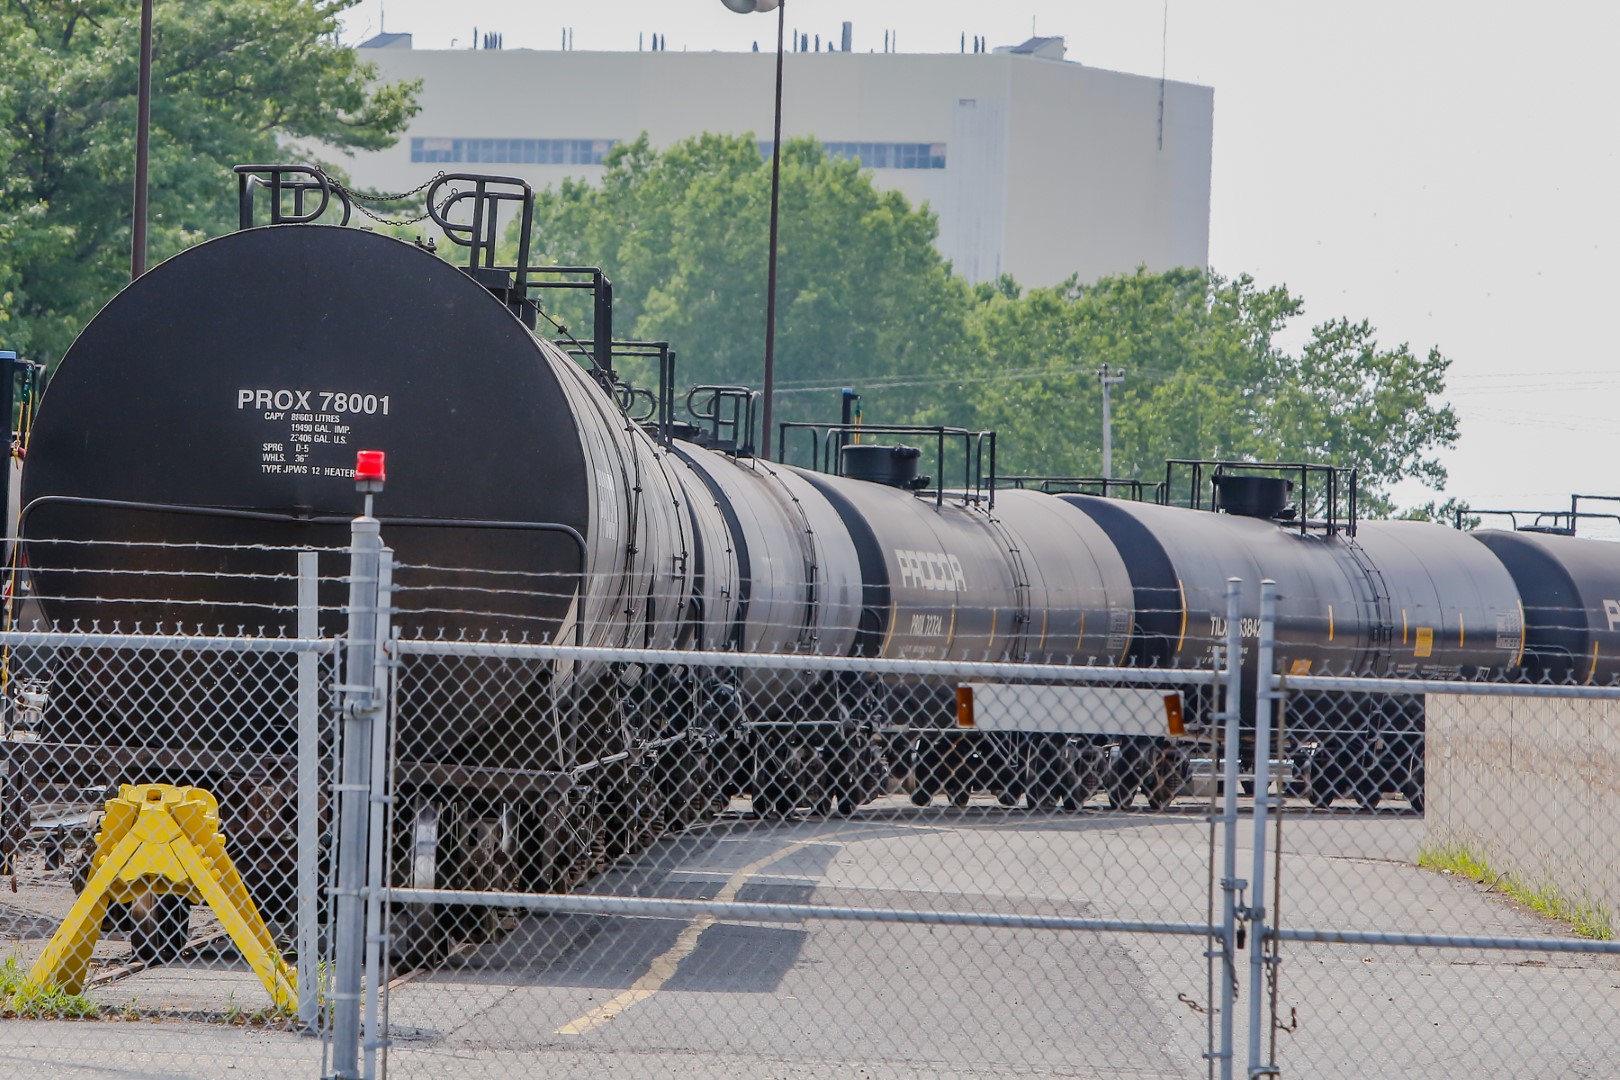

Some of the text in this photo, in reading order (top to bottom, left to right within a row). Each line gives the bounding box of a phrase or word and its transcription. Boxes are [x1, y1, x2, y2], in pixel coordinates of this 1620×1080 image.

[237, 389, 390, 415] PROX 78001
[264, 411, 285, 421] CAPY
[315, 413, 340, 423] LITRES
[291, 423, 351, 434] 19490 GAL. IMP.
[313, 434, 331, 444] GAL.
[333, 435, 348, 445] U.S.
[262, 442, 310, 453] SPRG D-5
[262, 453, 309, 463] WHLS. 36"
[261, 464, 282, 474] TYPE
[283, 464, 308, 474] JPWS
[311, 466, 321, 476] 12
[1210, 615, 1229, 636] TILX
